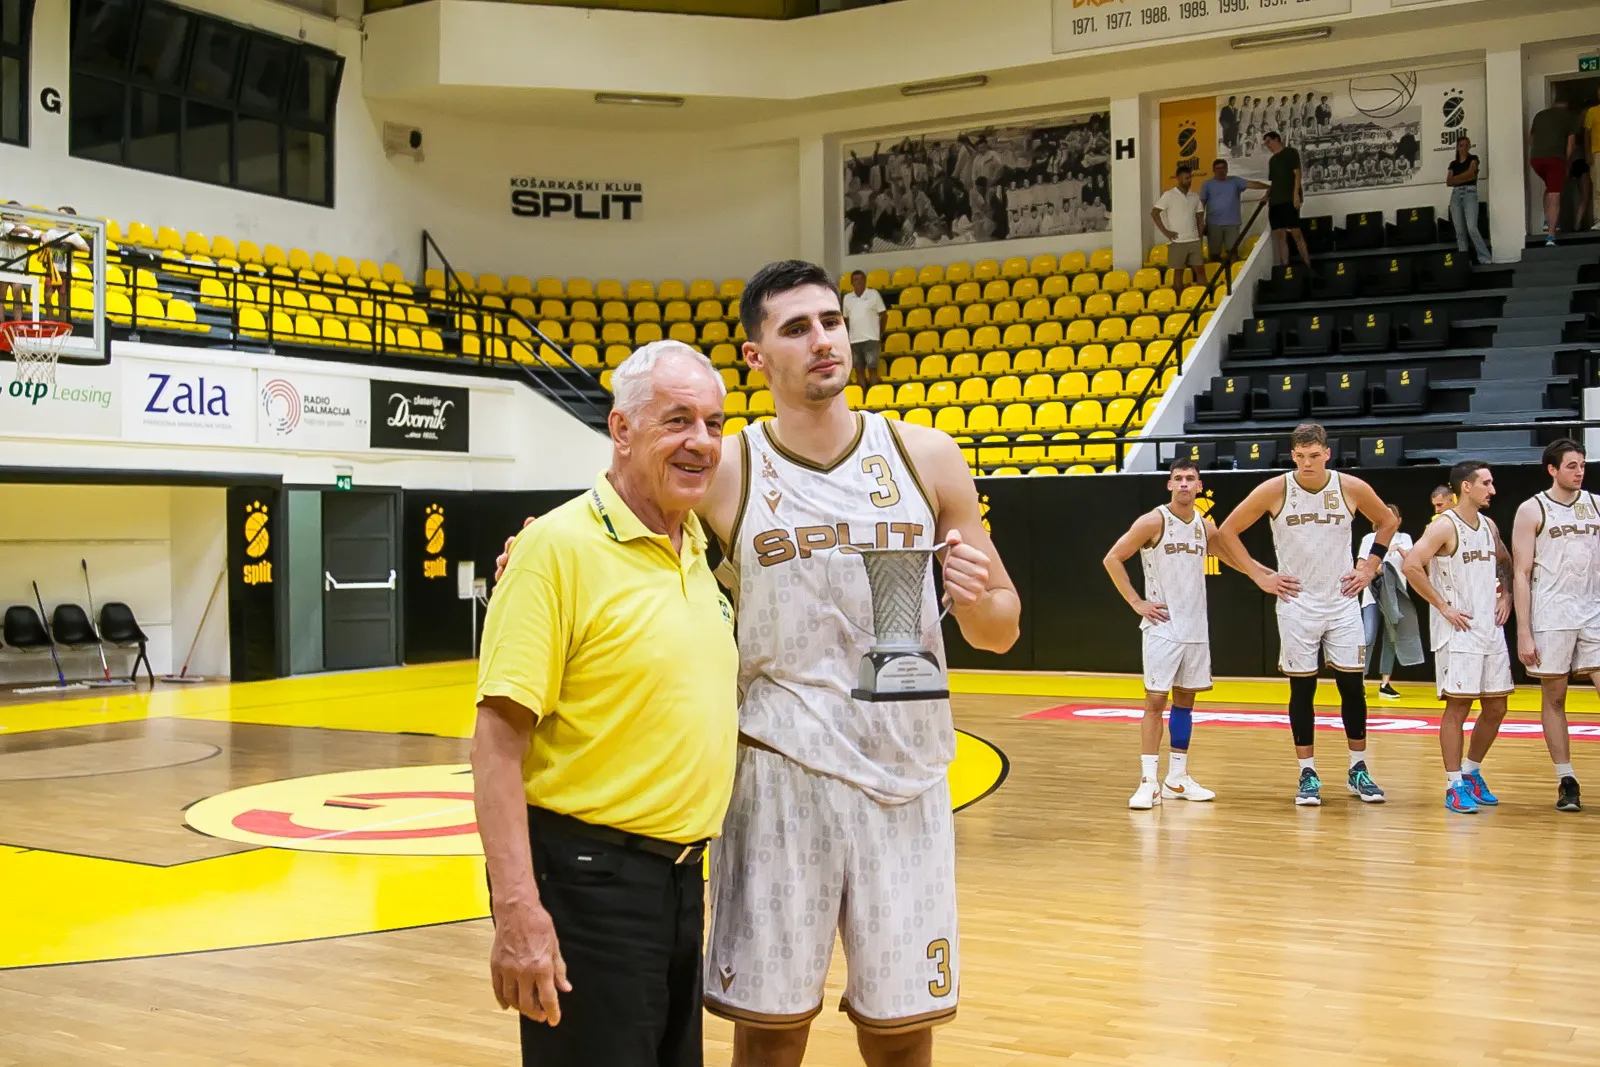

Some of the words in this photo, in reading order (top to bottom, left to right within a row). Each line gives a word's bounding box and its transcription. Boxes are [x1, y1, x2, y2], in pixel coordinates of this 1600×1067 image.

[1072, 17, 1098, 35] 1971.
[1106, 11, 1132, 30] 1977.
[1140, 6, 1171, 25] 1988.
[1179, 0, 1209, 20] 1989.
[40, 87, 61, 115] G
[1115, 137, 1136, 160] H
[510, 177, 600, 191] KOŠARKAŠKI
[605, 182, 642, 192] KLUB
[511, 189, 643, 220] SPLIT
[9, 378, 48, 405] otp
[52, 383, 112, 408] Leasing
[144, 373, 229, 417] Zala
[303, 395, 331, 406] RADIO
[303, 405, 351, 416] DALMACIJA
[387, 393, 455, 430] Dvornik
[861, 455, 901, 508] 3
[1323, 489, 1340, 510] 15
[1285, 512, 1346, 527] SPLIT
[753, 522, 924, 568] SPLIT
[1164, 542, 1205, 557] SPLIT
[243, 560, 273, 586] split
[423, 557, 448, 578] split
[927, 937, 952, 998] 3
